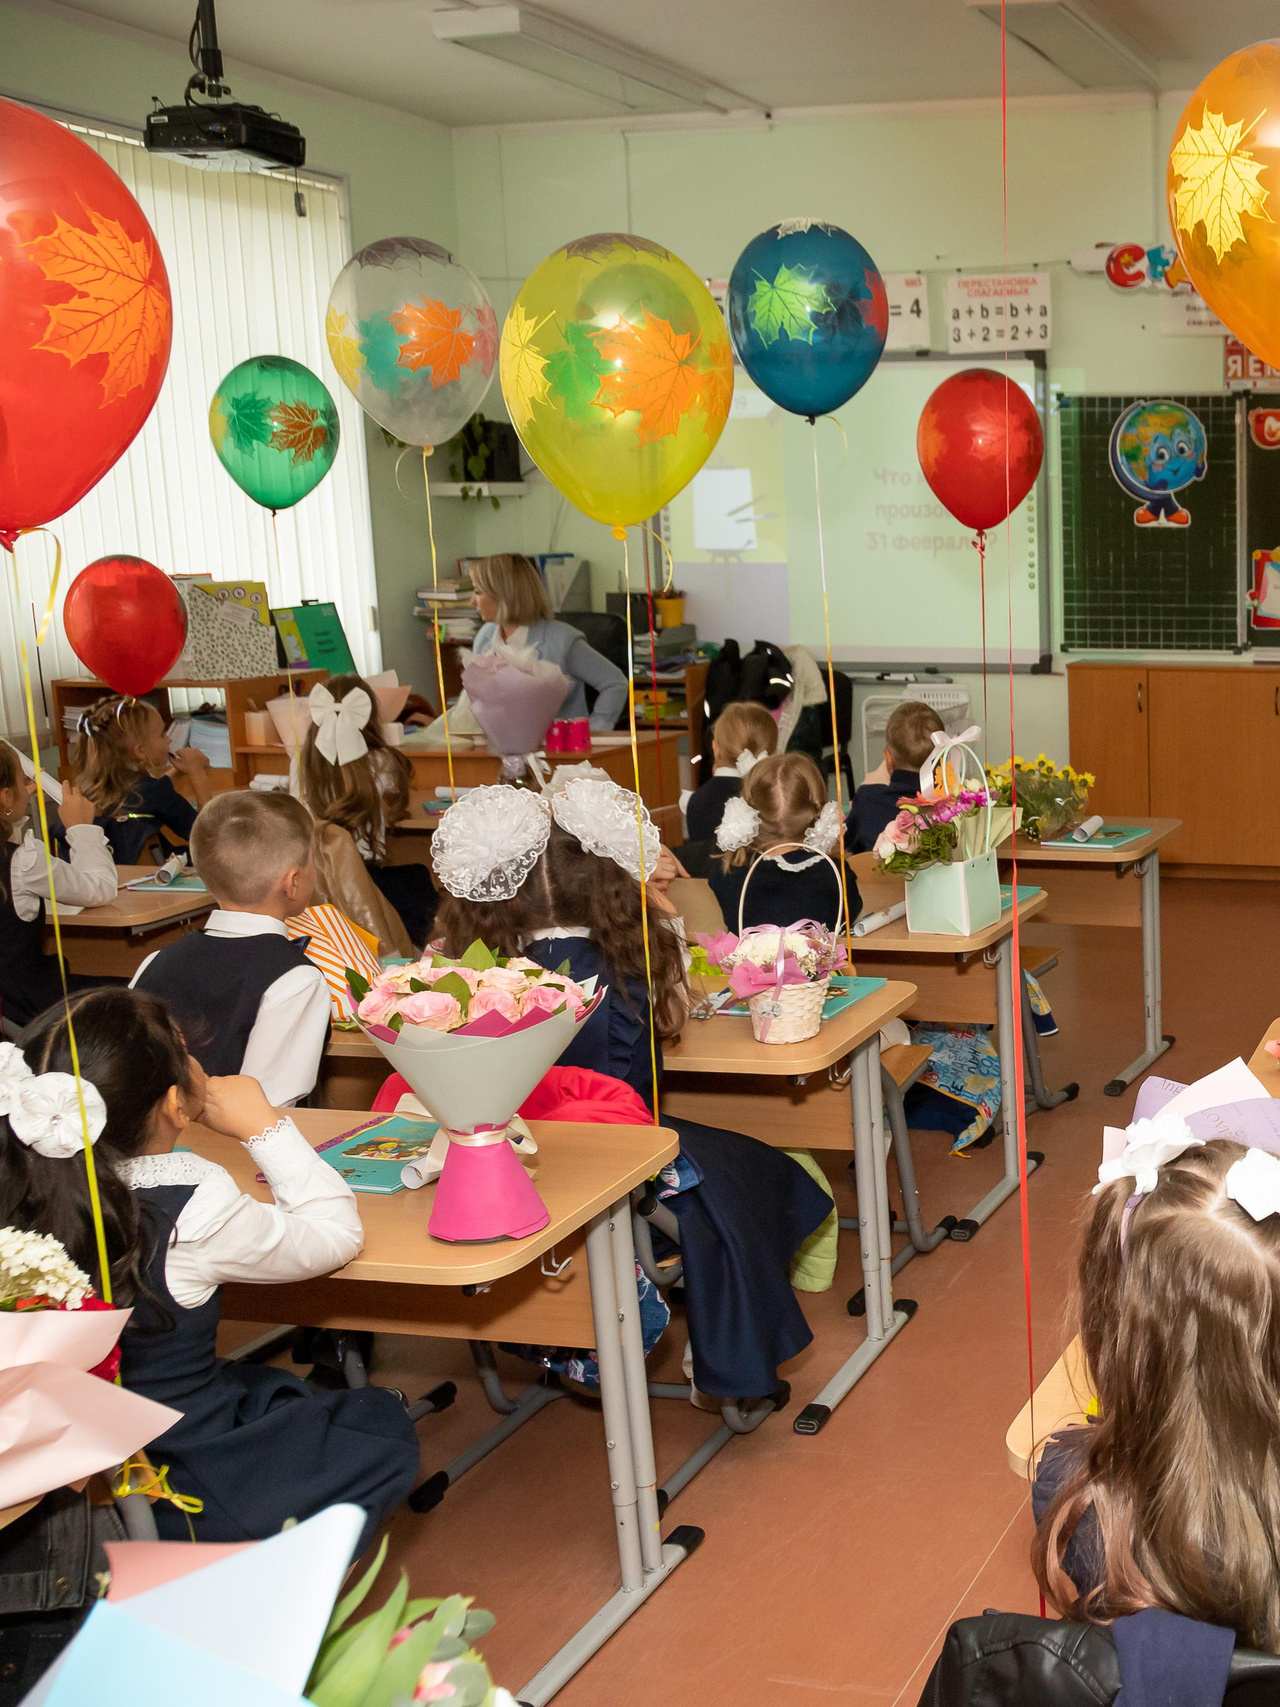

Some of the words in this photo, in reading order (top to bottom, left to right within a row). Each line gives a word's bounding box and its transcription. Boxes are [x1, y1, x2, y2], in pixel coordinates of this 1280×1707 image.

[909, 297, 922, 318] 4
[873, 468, 911, 486] Что
[865, 532, 887, 551] 31
